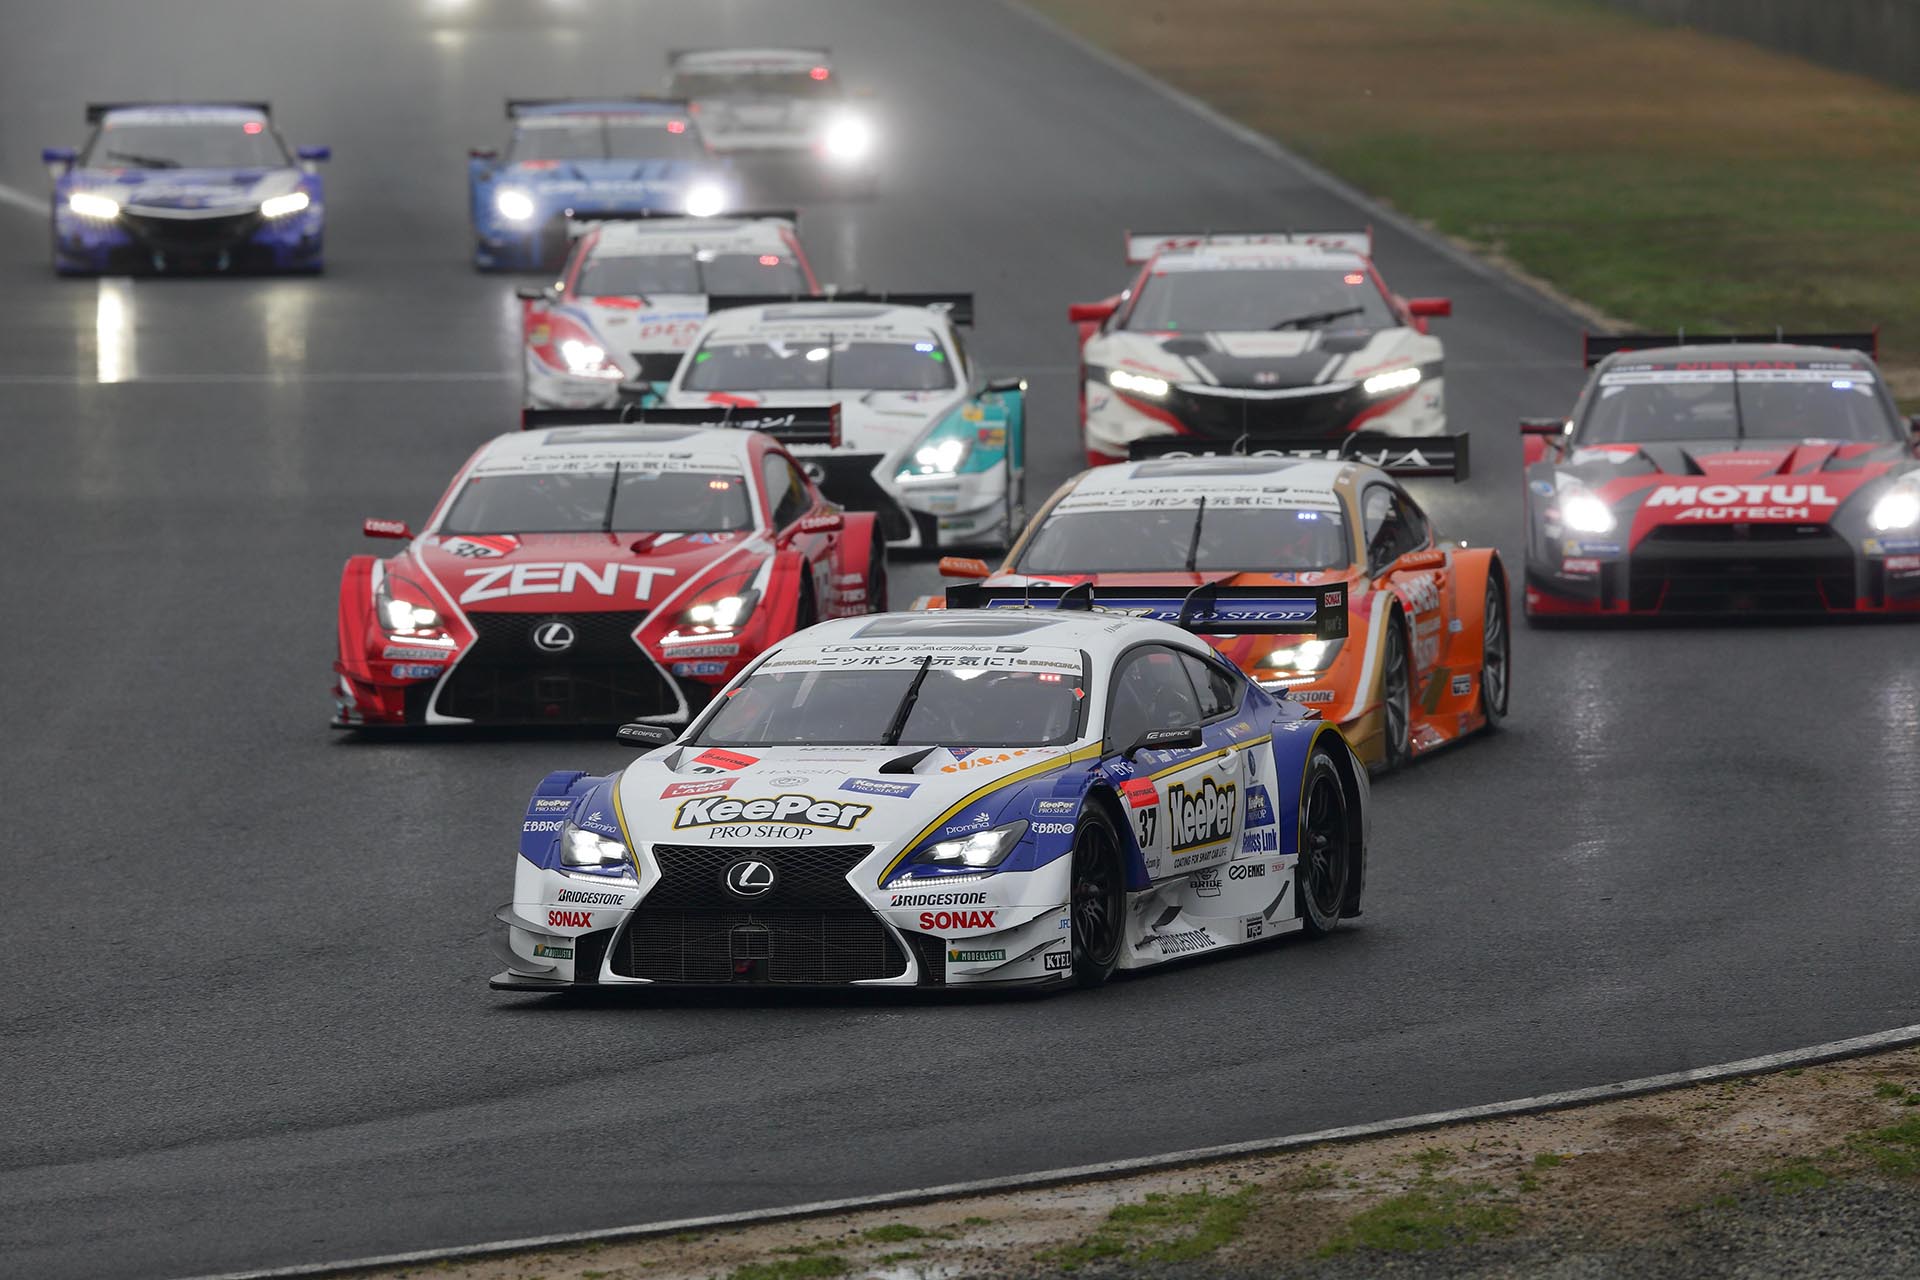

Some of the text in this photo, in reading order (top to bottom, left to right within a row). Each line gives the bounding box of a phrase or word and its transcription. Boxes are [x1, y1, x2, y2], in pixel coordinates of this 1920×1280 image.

[1645, 485, 1839, 507] MOTUL
[1675, 507, 1808, 521] AUTECH
[459, 562, 676, 605] ZENT
[1223, 611, 1305, 622] SHOP
[632, 730, 663, 739] EDIFICE
[1158, 730, 1192, 738] EDIFICE
[671, 785, 723, 796] LABO
[536, 799, 572, 808] KeePer
[1039, 801, 1075, 810] KeePer
[674, 795, 871, 829] KeePer
[1169, 779, 1236, 853] KeePer
[522, 821, 565, 833] EBBRO
[708, 826, 814, 840] PRO SHOP
[945, 822, 990, 836] promina
[1031, 822, 1075, 834] EBBRO
[1139, 808, 1158, 849] 37
[1173, 855, 1191, 869] COATING
[1248, 864, 1266, 878] ENKEI
[1190, 879, 1223, 889] BRIDE
[558, 889, 626, 906] BRIDGESTONE
[890, 892, 987, 907] BRIDGESTONE
[548, 910, 593, 929] SONAX
[919, 911, 997, 930] SONAX
[961, 952, 1003, 961] MODELLISTA
[1045, 956, 1071, 970] KTEL
